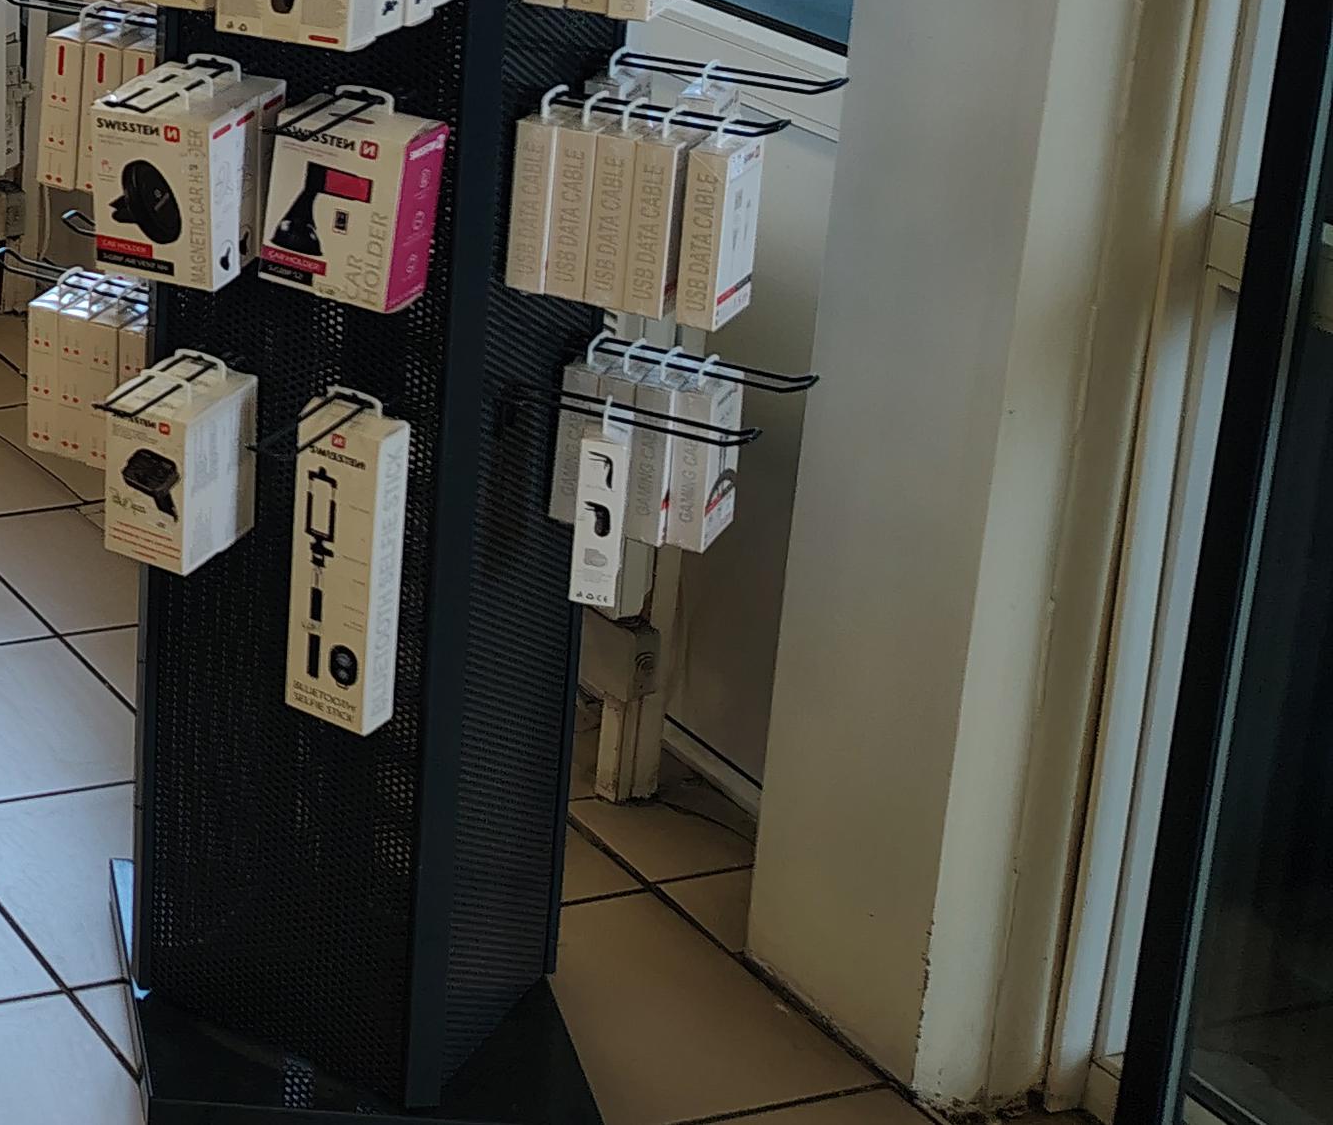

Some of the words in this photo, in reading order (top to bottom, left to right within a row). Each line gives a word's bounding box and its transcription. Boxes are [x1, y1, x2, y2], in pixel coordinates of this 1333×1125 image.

[96, 117, 160, 137] SWISSTEN
[521, 143, 544, 195] CABLE
[561, 149, 585, 202] CABLE
[601, 157, 625, 211] CABLE
[189, 185, 204, 214] CAR
[640, 164, 664, 219] CABLE
[693, 173, 717, 228] CABLE
[518, 201, 539, 239] DATA
[557, 207, 581, 247] DATA
[597, 216, 619, 256] DATA
[190, 218, 205, 283] MAGNETIC
[362, 212, 388, 306] HOLDER
[516, 244, 535, 274] USB
[635, 224, 660, 264] DATA
[688, 234, 712, 275] DATA
[344, 255, 362, 299] CAR
[555, 250, 576, 282] USB
[594, 259, 614, 290] USB
[631, 268, 653, 299] USB
[684, 279, 707, 311] USB
[383, 446, 404, 511] STICK
[378, 514, 397, 589] SELFIE
[370, 592, 394, 715] BLUETOOTH
